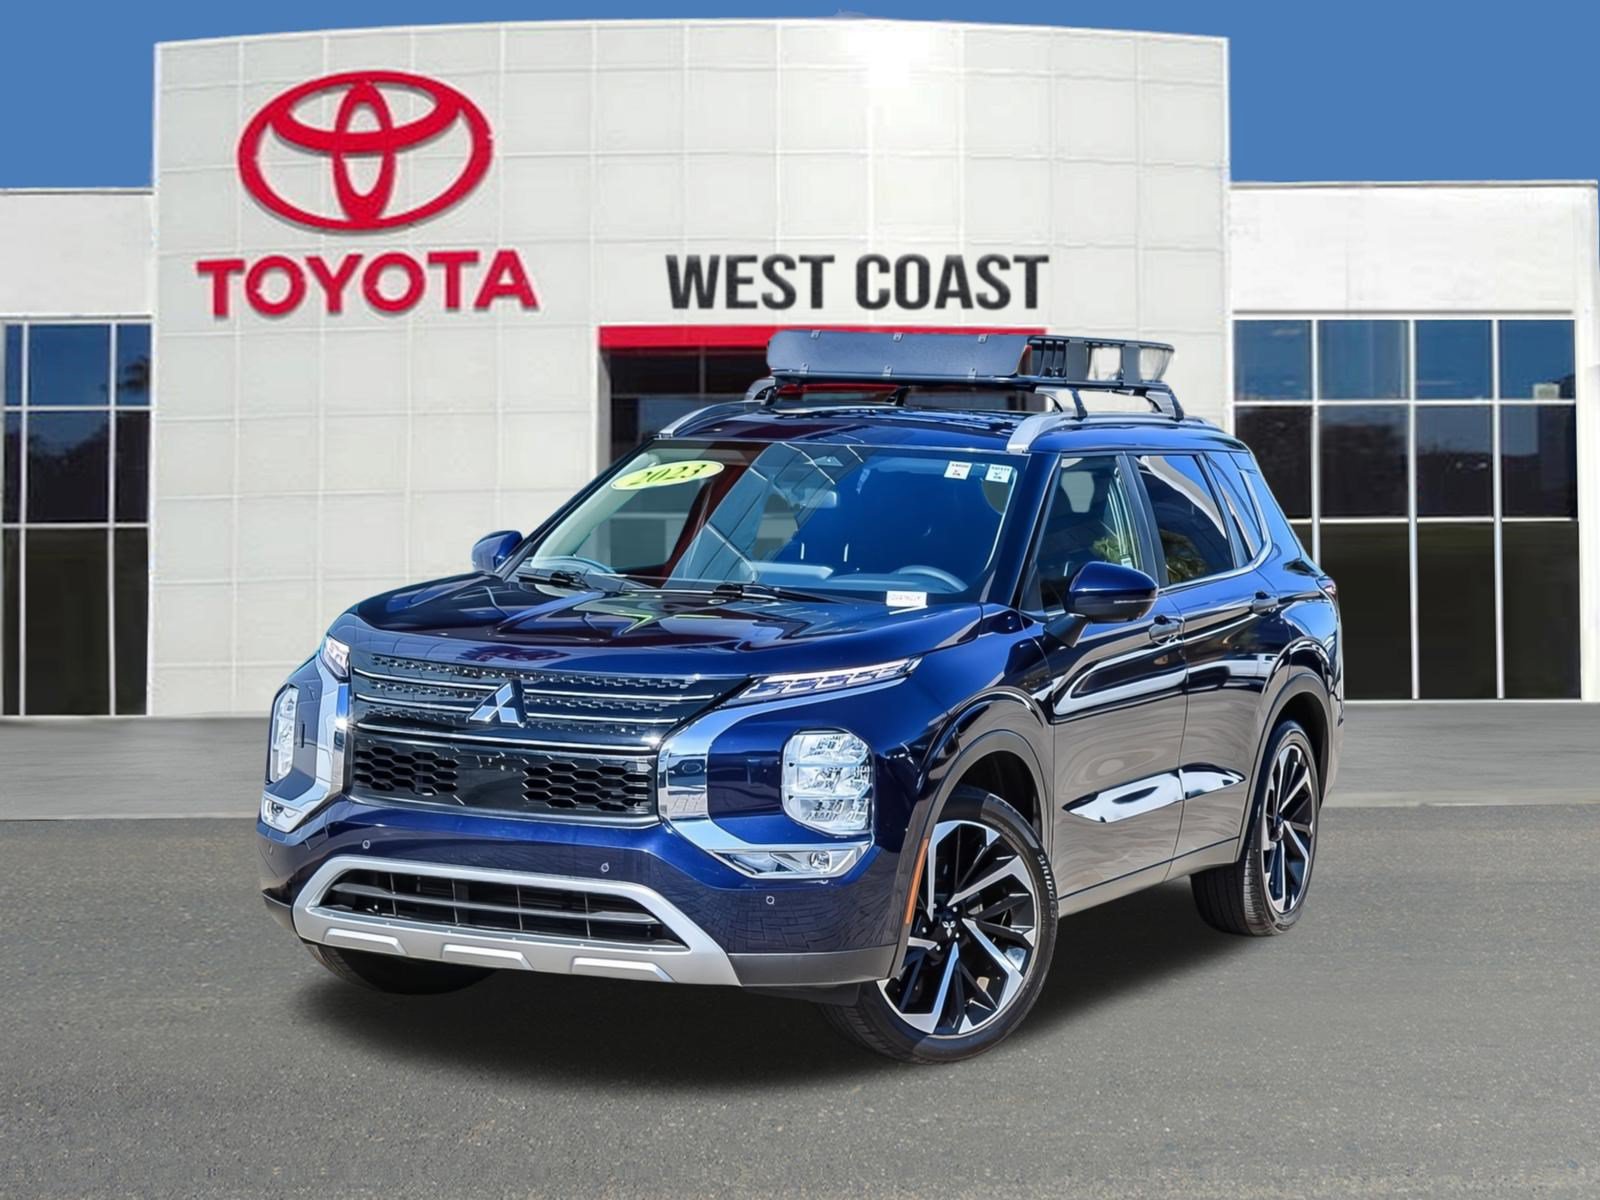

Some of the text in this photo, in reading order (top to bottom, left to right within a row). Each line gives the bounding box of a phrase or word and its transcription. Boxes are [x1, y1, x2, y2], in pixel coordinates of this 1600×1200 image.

[196, 250, 540, 318] TOYOTA
[666, 253, 1049, 310] WEST COAST
[626, 464, 707, 486] 2023
